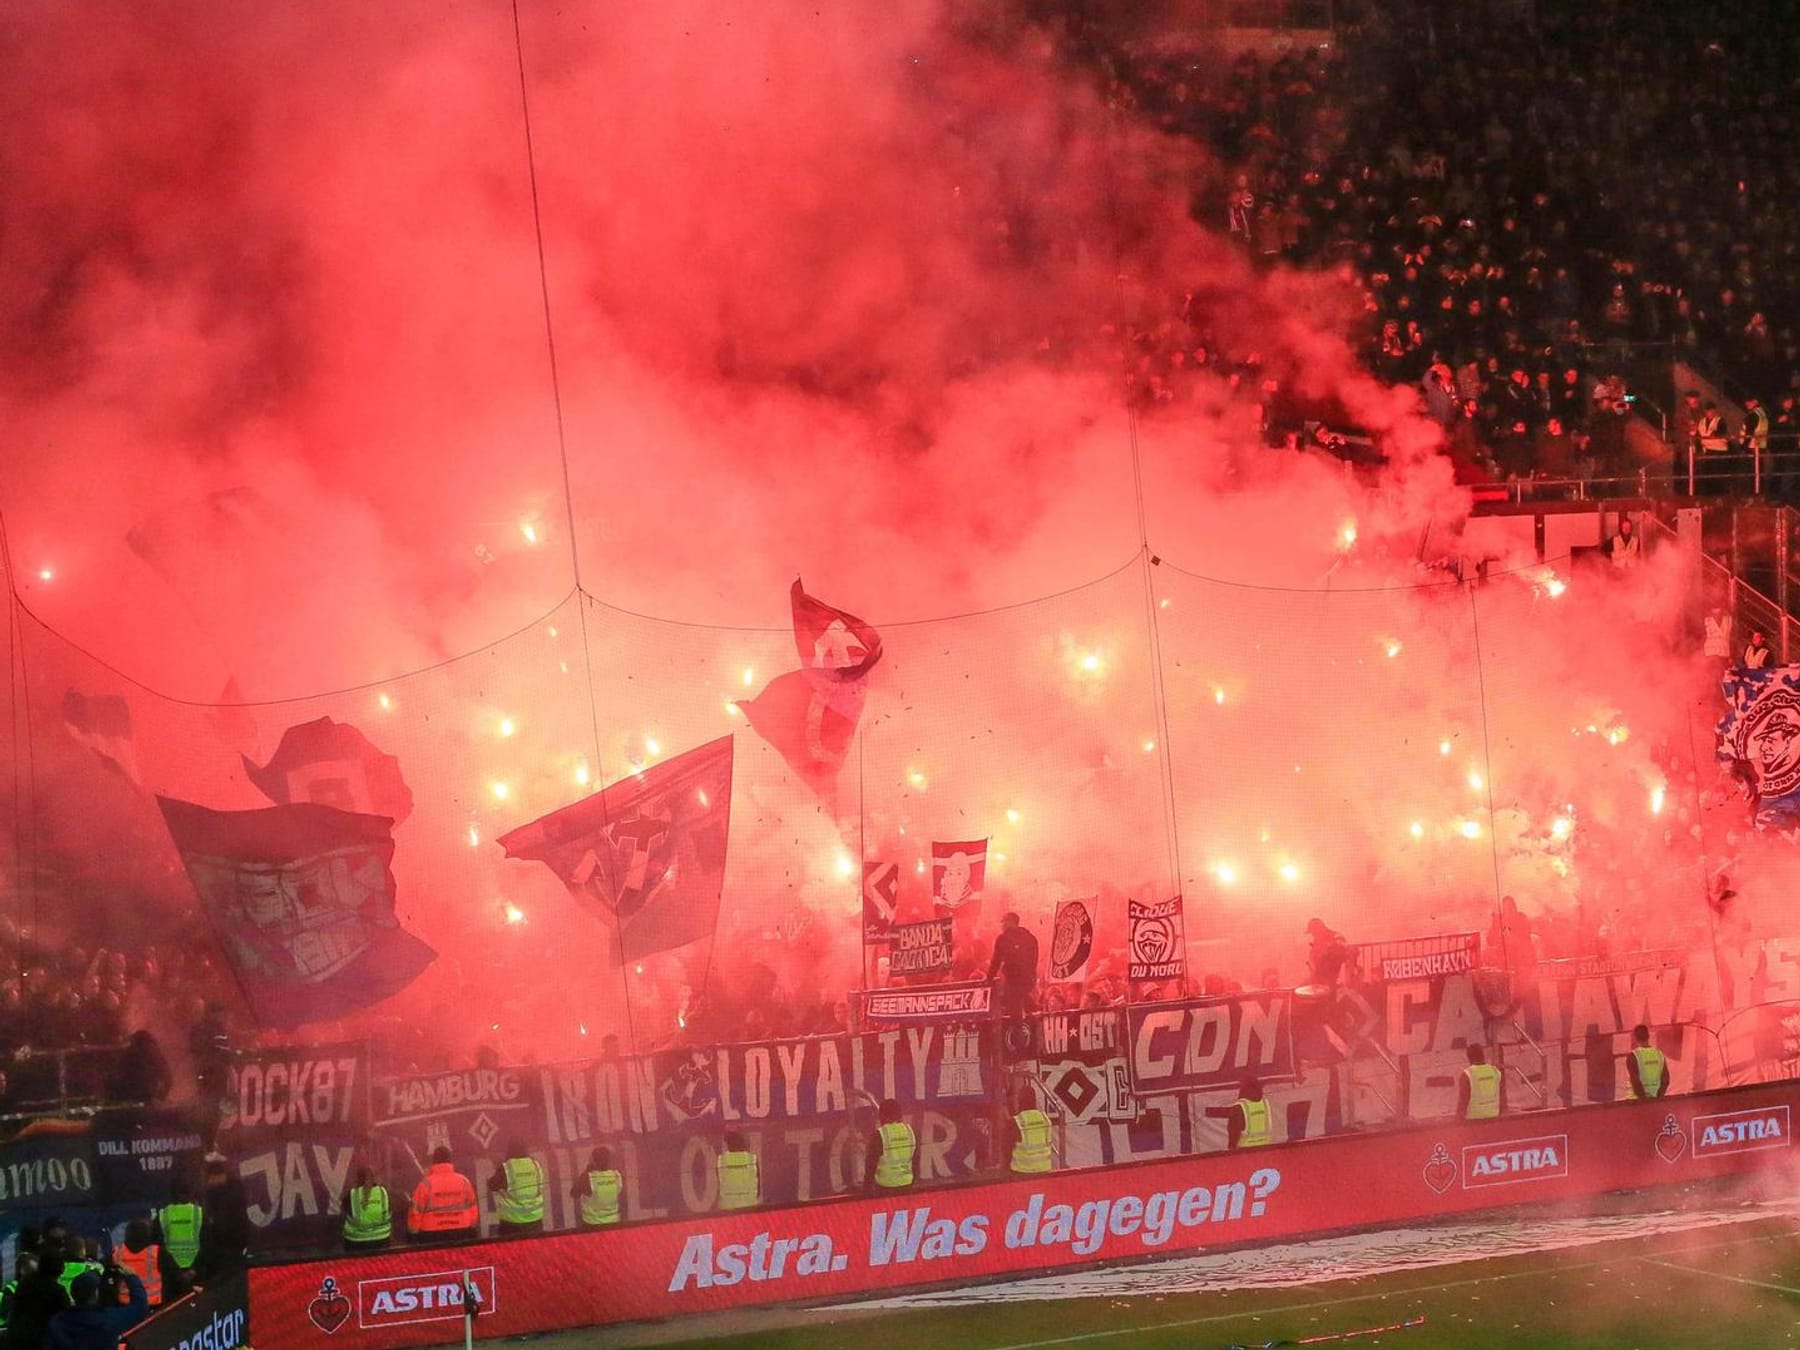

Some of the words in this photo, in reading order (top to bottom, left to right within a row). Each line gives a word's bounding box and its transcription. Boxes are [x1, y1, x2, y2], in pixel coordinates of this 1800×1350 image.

[871, 992, 970, 1014] SEEMANNSPACK
[1136, 999, 1283, 1080] CDN
[388, 1067, 522, 1114] HAMBURG
[717, 1026, 935, 1121] LOYALTY
[1700, 1117, 1781, 1147] ASTRA
[1471, 1147, 1559, 1177] ASTRA
[667, 1230, 849, 1293] Astra.
[868, 1206, 990, 1267] Was
[1004, 1168, 1281, 1256] dagegen?
[370, 1280, 484, 1316] ASTRA
